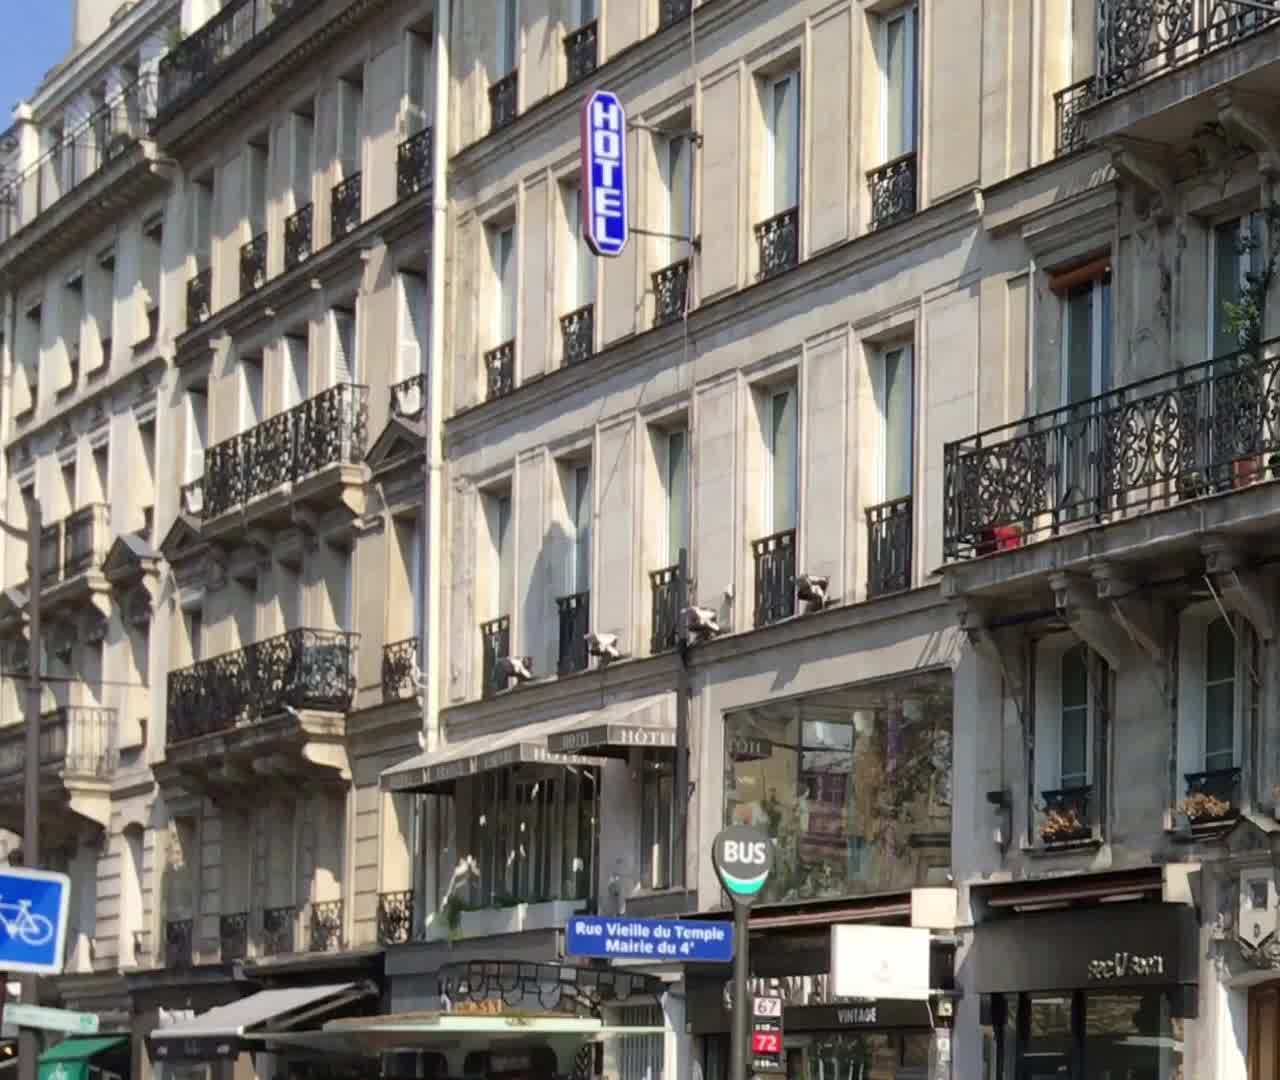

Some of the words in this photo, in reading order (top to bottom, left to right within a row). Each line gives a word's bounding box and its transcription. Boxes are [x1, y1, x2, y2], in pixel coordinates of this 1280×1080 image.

[594, 101, 621, 245] HOTEL
[723, 840, 766, 864] BUS
[575, 921, 602, 936] Rue
[606, 922, 650, 939] Vieille
[654, 925, 672, 939] du
[675, 926, 725, 942] Temple
[605, 938, 653, 953] Mairie
[658, 940, 676, 955] du
[757, 999, 777, 1015] 67
[837, 1007, 877, 1023] VINTAGE
[756, 1035, 777, 1051] 72
